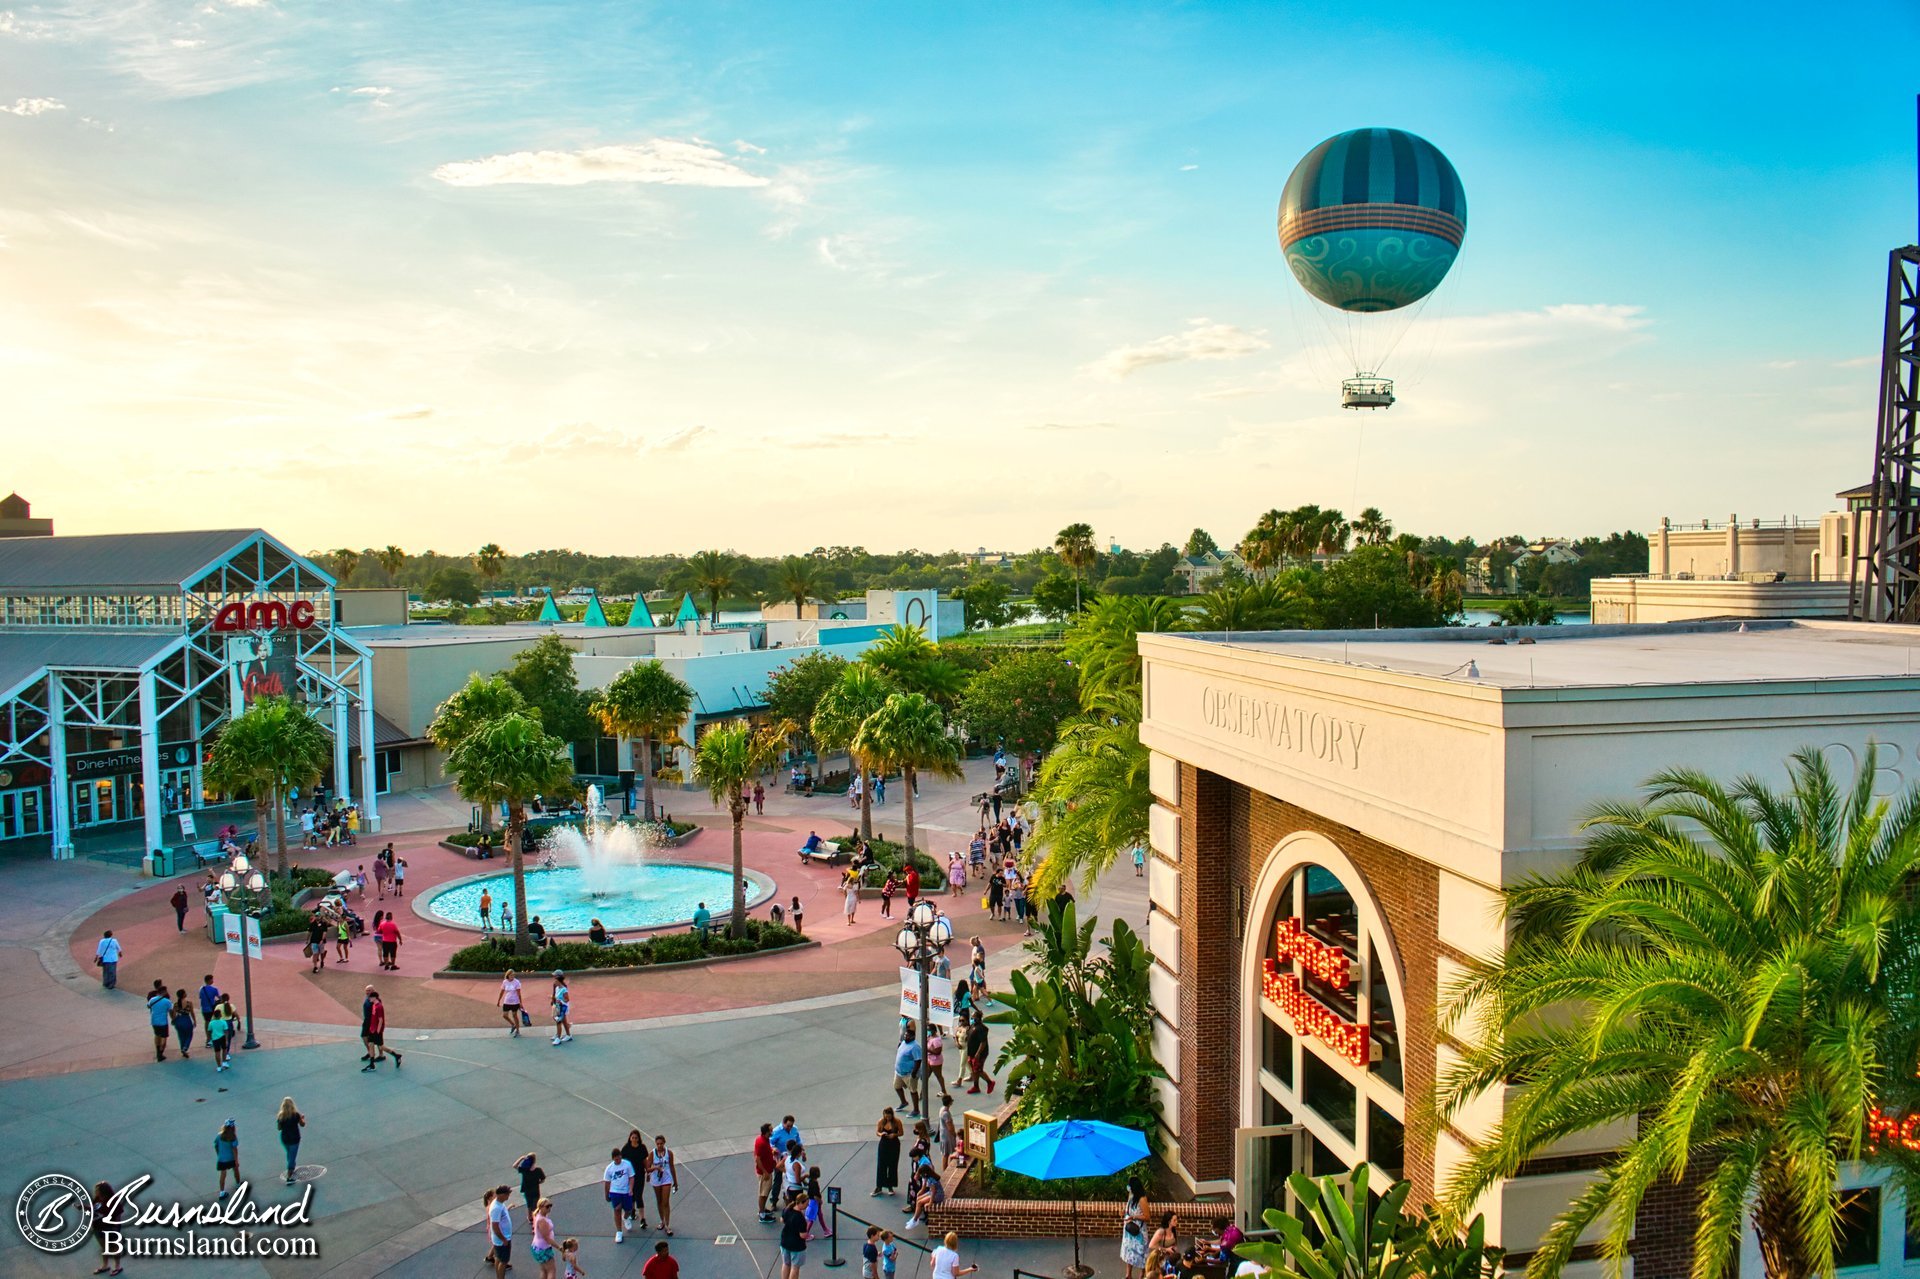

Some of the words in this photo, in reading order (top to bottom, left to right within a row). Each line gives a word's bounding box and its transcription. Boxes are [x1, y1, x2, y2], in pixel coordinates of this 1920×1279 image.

[1202, 686, 1367, 770] OBSERVATORY
[1277, 917, 1350, 989] planet
[1262, 958, 1370, 1067] hollywood
